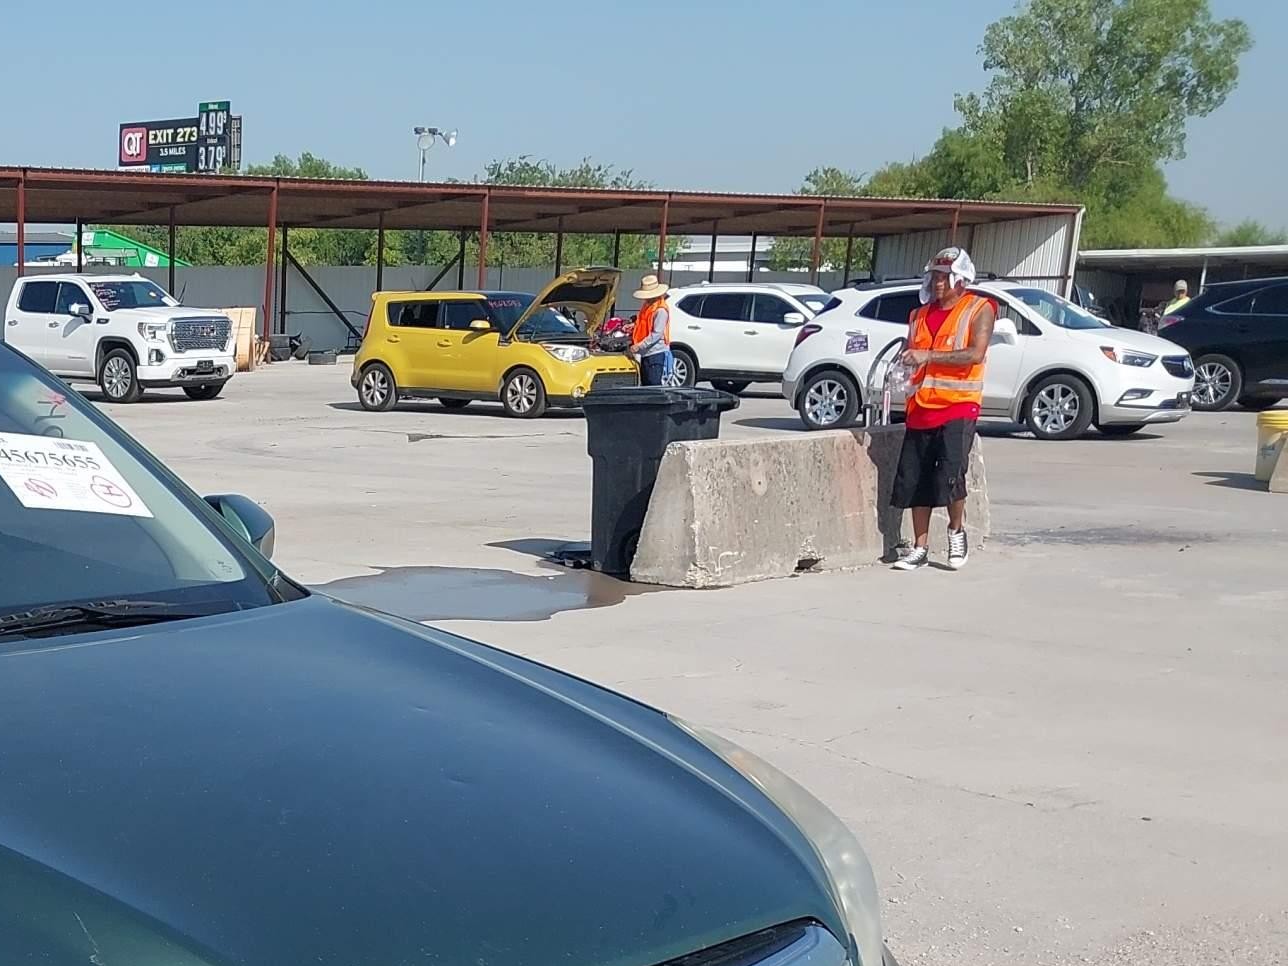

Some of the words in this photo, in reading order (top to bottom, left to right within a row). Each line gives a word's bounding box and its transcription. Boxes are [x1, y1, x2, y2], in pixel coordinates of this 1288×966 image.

[124, 132, 143, 157] QT
[149, 130, 174, 145] EXIT
[176, 127, 198, 142] 273
[169, 147, 186, 155] MILES
[0, 448, 101, 470] 45675655
